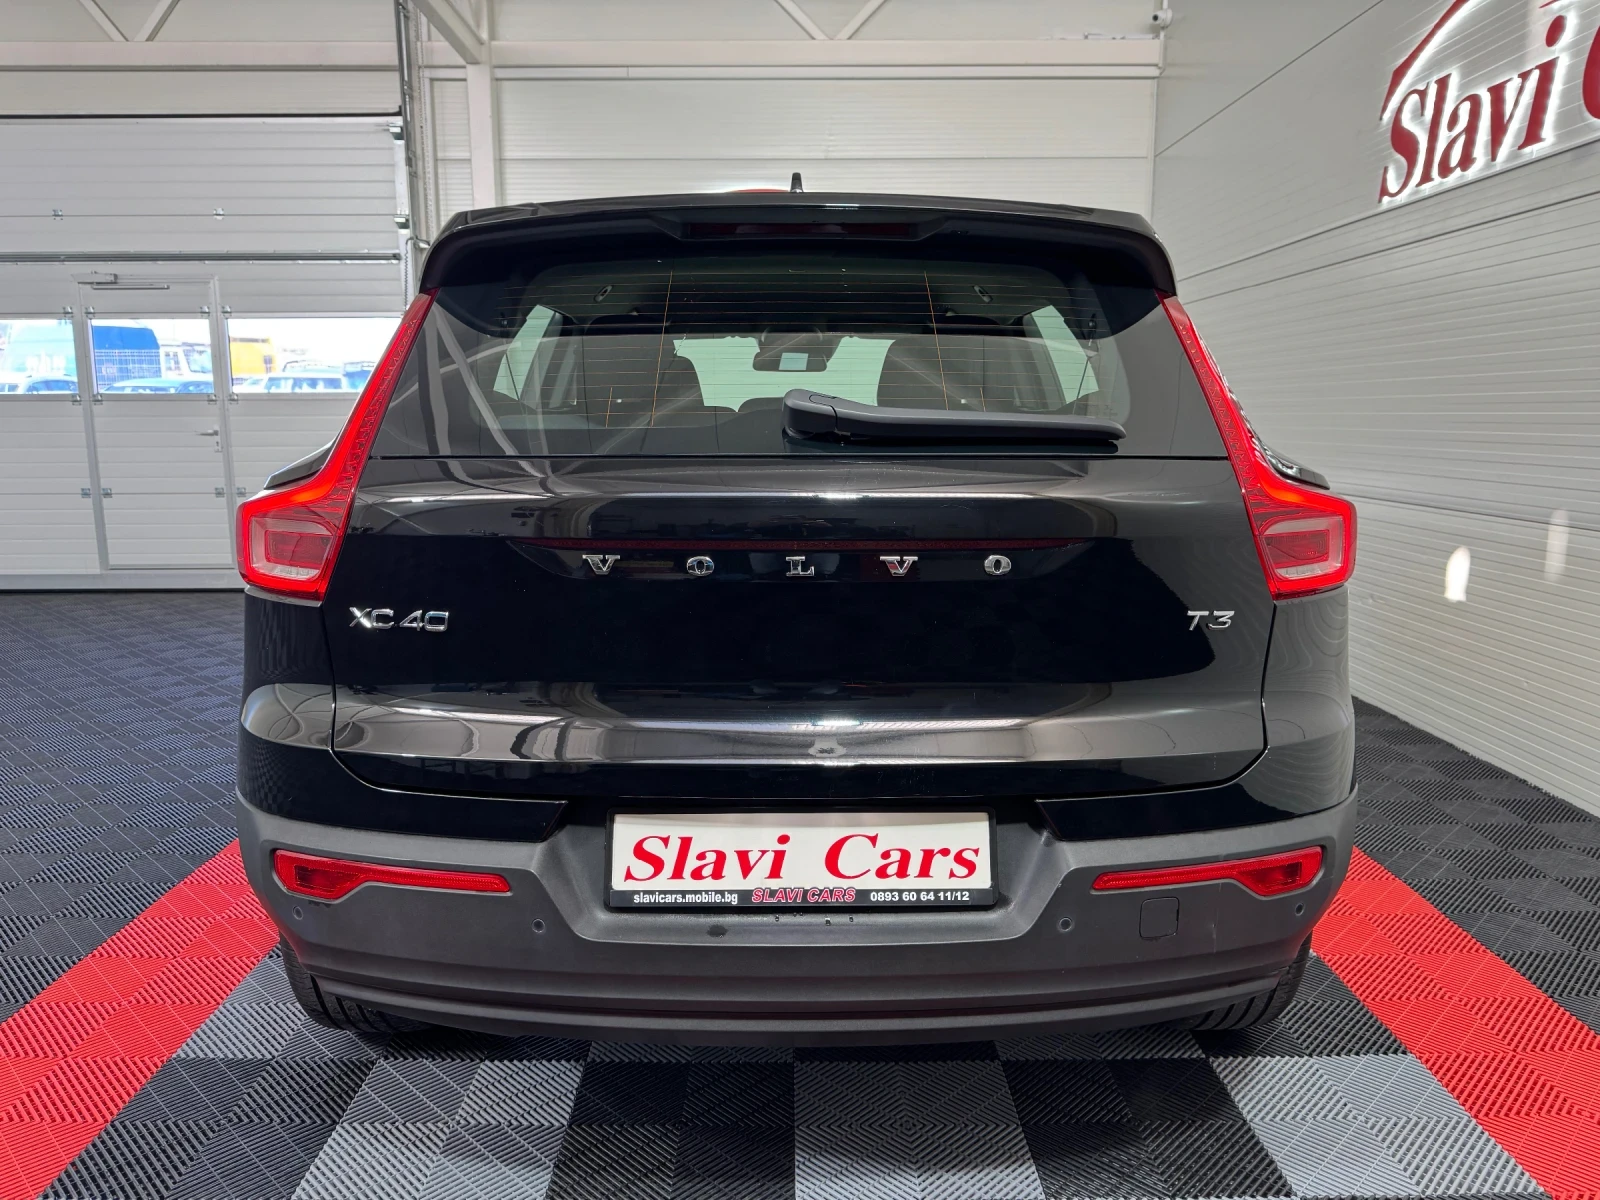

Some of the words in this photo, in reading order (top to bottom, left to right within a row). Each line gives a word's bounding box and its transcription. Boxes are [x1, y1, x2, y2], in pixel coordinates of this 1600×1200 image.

[1378, 14, 1567, 204] Slavi
[582, 554, 1012, 577] VOLVO
[1187, 610, 1235, 631] T3
[624, 833, 791, 883] Slavi
[823, 833, 981, 881] Cars
[633, 891, 738, 905] slavicars.mobile.bg
[751, 888, 804, 903] SLAVI
[806, 887, 857, 903] CARS
[870, 891, 900, 902] 0893
[902, 891, 917, 902] 60
[920, 891, 936, 902] 64
[937, 891, 970, 901] 11/12
